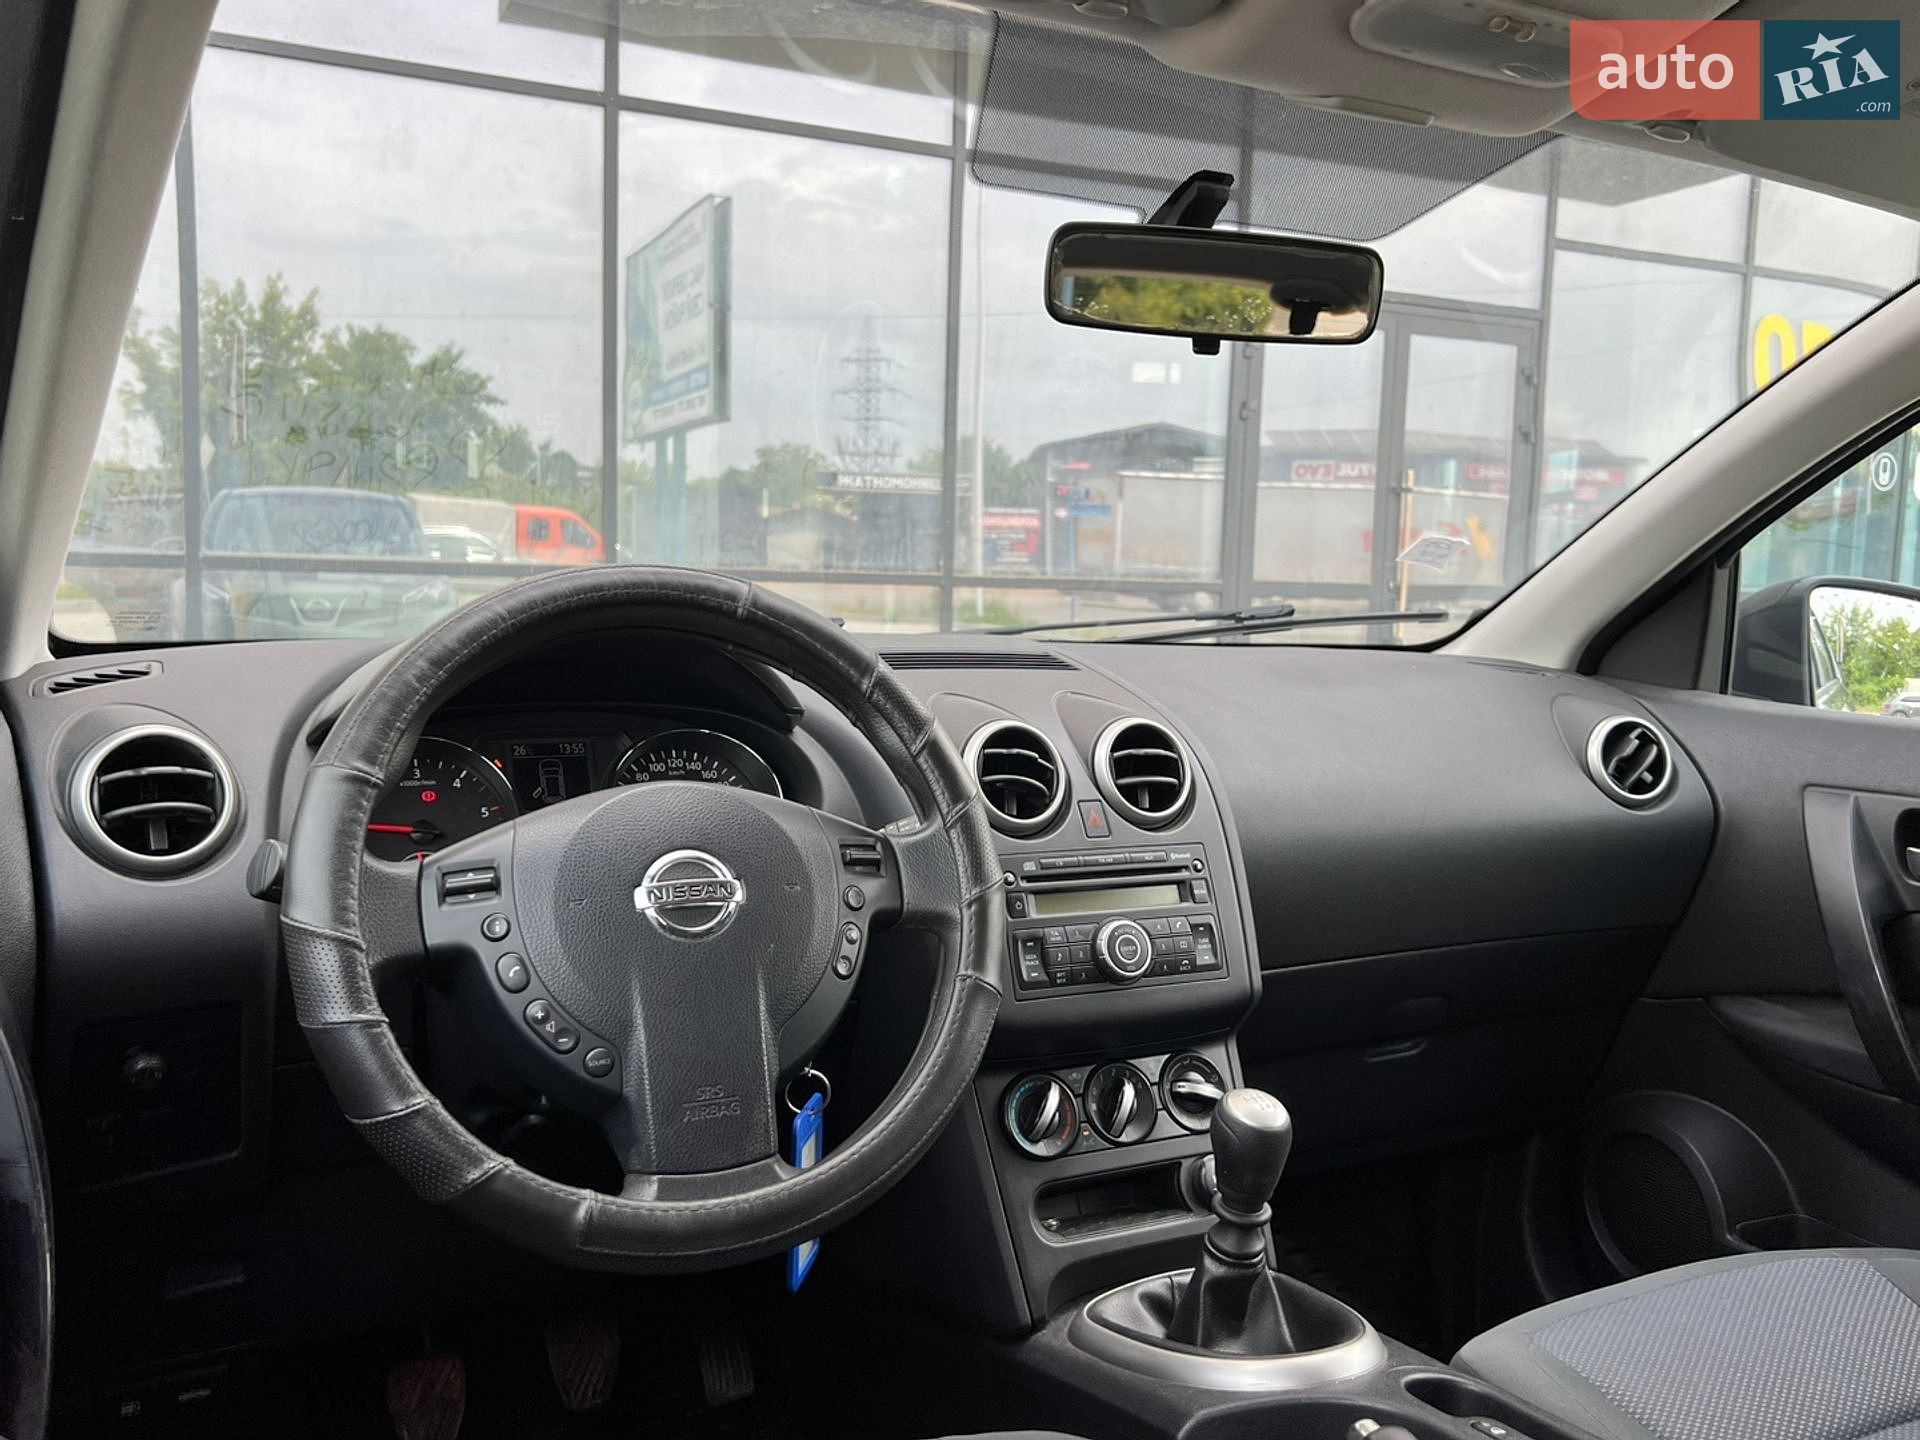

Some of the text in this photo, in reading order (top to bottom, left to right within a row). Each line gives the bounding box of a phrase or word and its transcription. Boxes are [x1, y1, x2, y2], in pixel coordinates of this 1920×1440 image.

[559, 743, 585, 755] 13:55
[648, 762, 666, 773] 100
[667, 758, 684, 768] 120
[685, 761, 702, 771] 140
[413, 768, 421, 779] 3
[635, 771, 650, 781] 80
[701, 769, 718, 780] 160
[452, 778, 462, 789] 4
[480, 806, 490, 818] 5
[649, 882, 733, 904] NISSAN
[697, 1084, 725, 1100] SRS
[683, 1101, 741, 1123] AIRBAG
